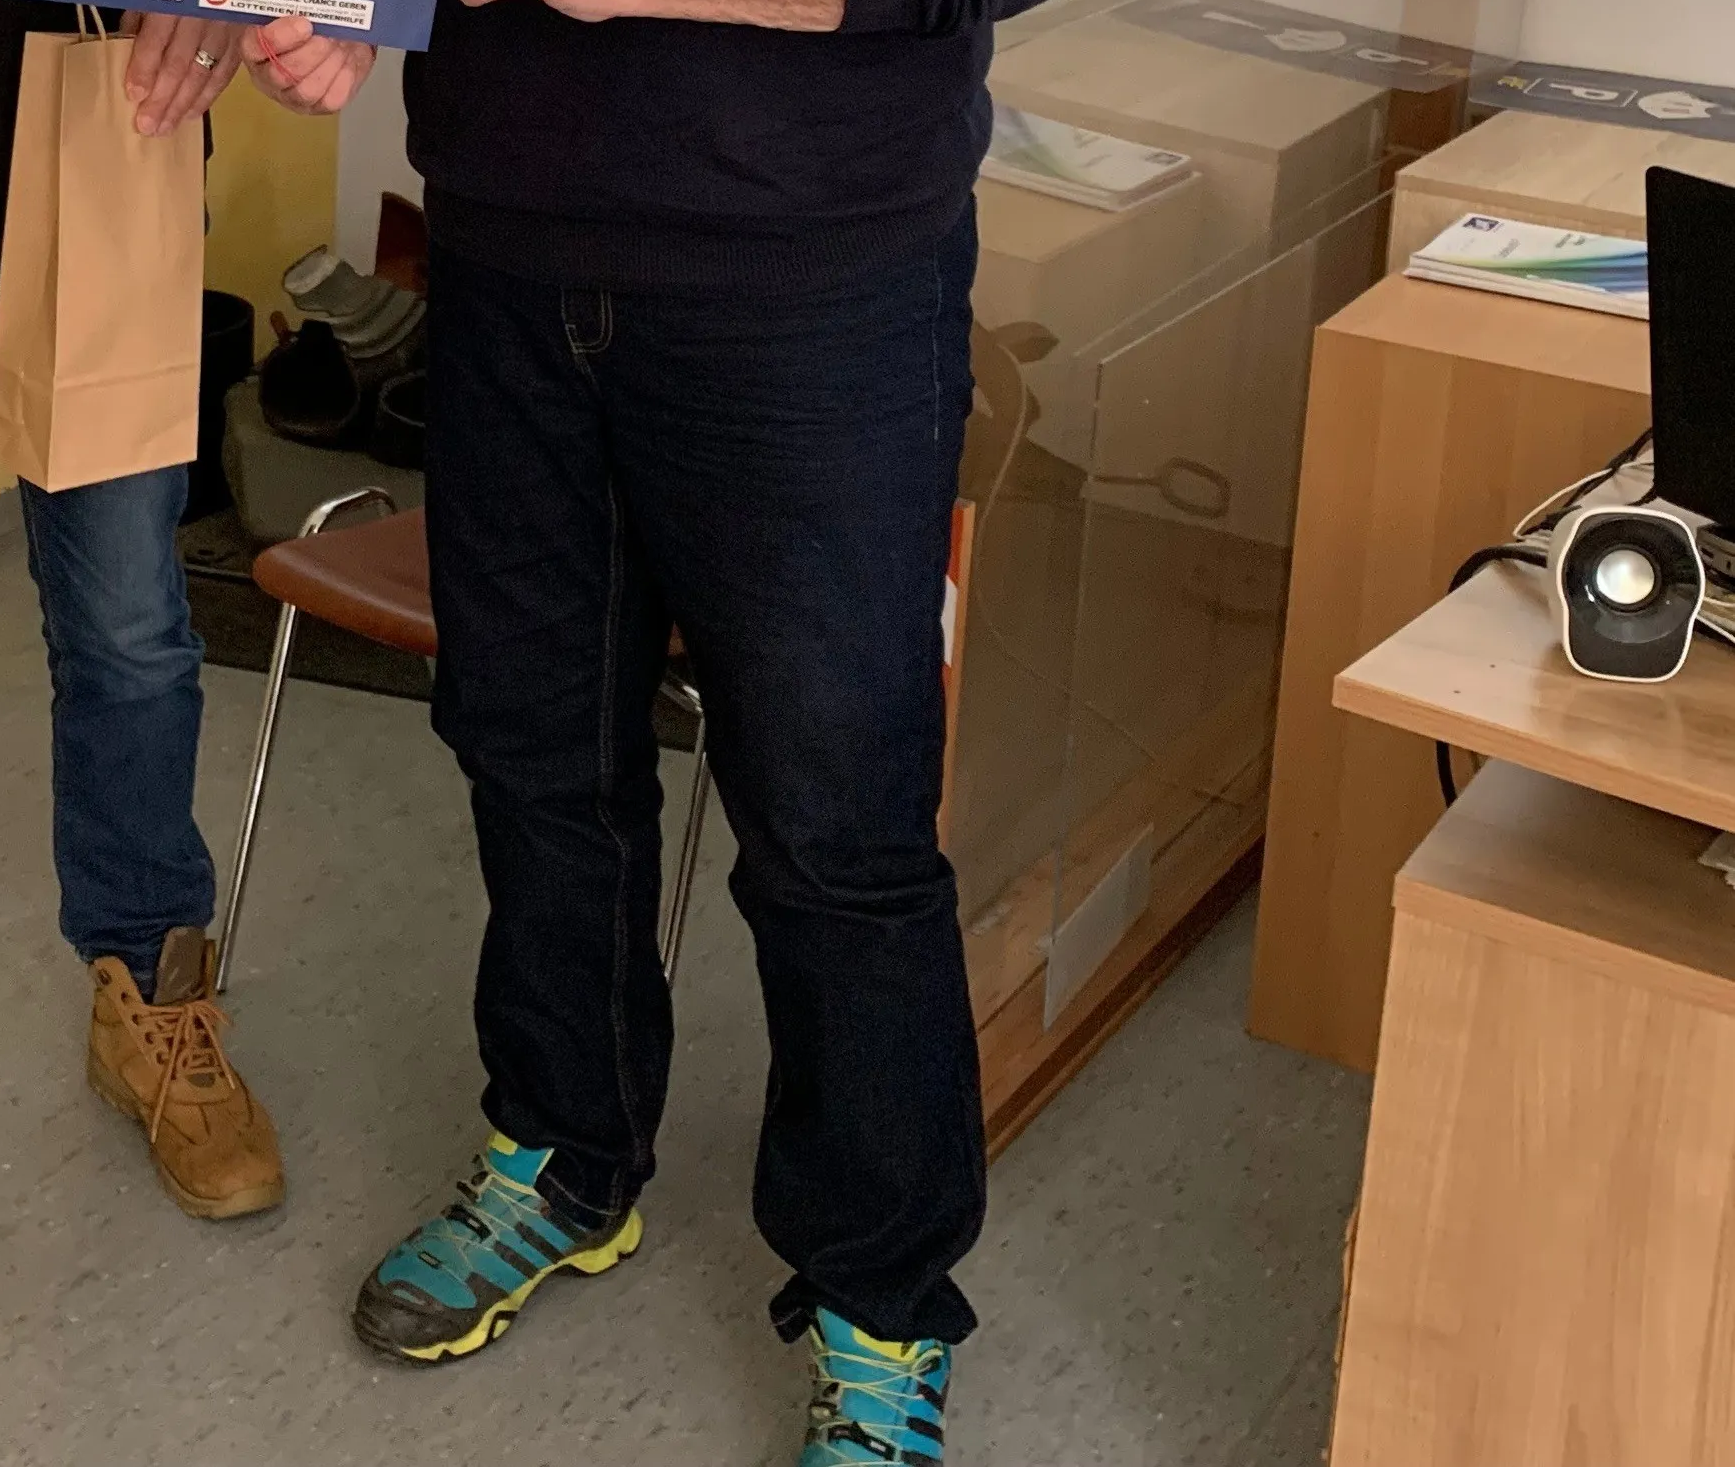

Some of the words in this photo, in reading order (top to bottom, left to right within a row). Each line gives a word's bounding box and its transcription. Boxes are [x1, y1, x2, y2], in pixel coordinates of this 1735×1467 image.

[231, 2, 294, 15] LOTTERIEN
[299, 11, 364, 25] SENIORENHILFE
[339, 2, 366, 10] GEBEN
